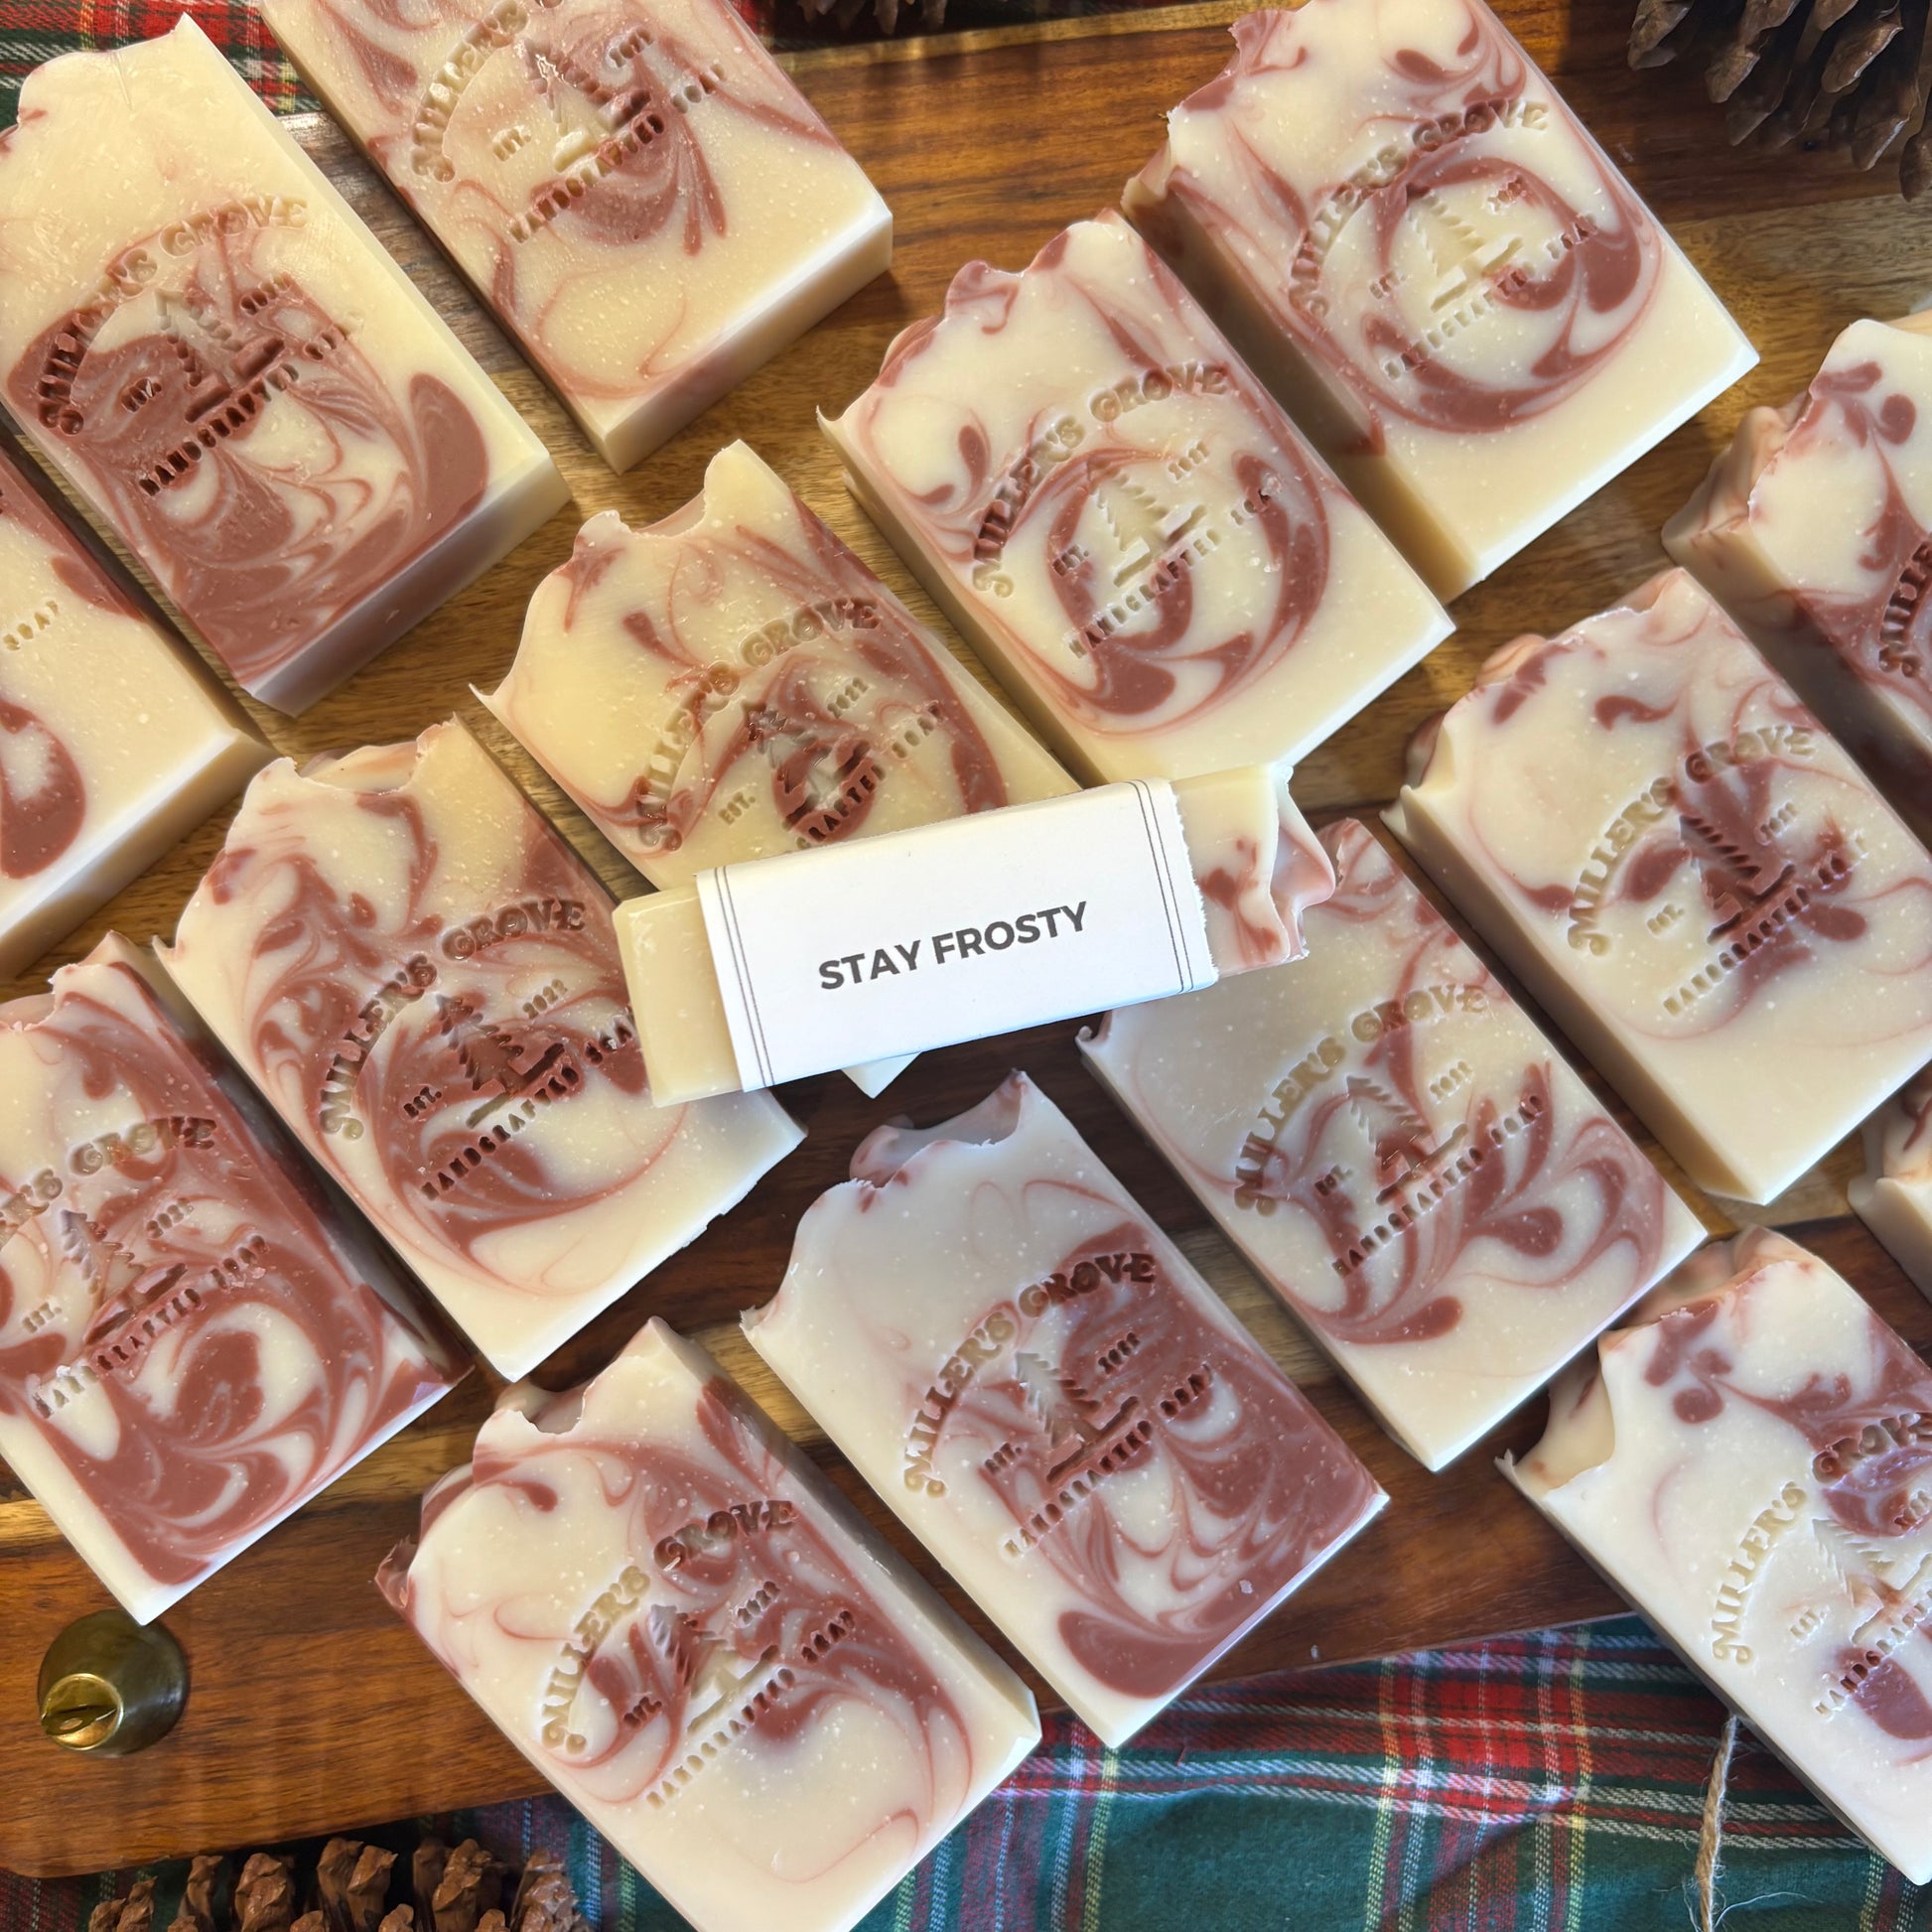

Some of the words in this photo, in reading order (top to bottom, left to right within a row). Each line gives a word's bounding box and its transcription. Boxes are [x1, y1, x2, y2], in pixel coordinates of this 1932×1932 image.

[1089, 361, 1229, 422] GROVE
[741, 598, 881, 667] GROVE
[718, 791, 757, 825] EST.
[1567, 776, 1677, 957] MILLER'S
[1685, 726, 1816, 783] GROVE
[319, 953, 438, 1141] MILLER'S
[442, 899, 586, 961] GROVE
[523, 979, 568, 1020] 2022
[818, 939, 921, 990] STAY
[931, 900, 1087, 965] FROSTY
[1234, 1035, 1346, 1217] MILLER'S
[1351, 984, 1488, 1043] GROVE
[903, 1311, 1015, 1499] MILLER'S
[1018, 1252, 1156, 1318] GROVE
[1712, 1480, 1807, 1667] MILLER'S
[541, 1565, 651, 1755] MILLER'S
[1815, 1589, 1932, 1718] HANDCRAFT
